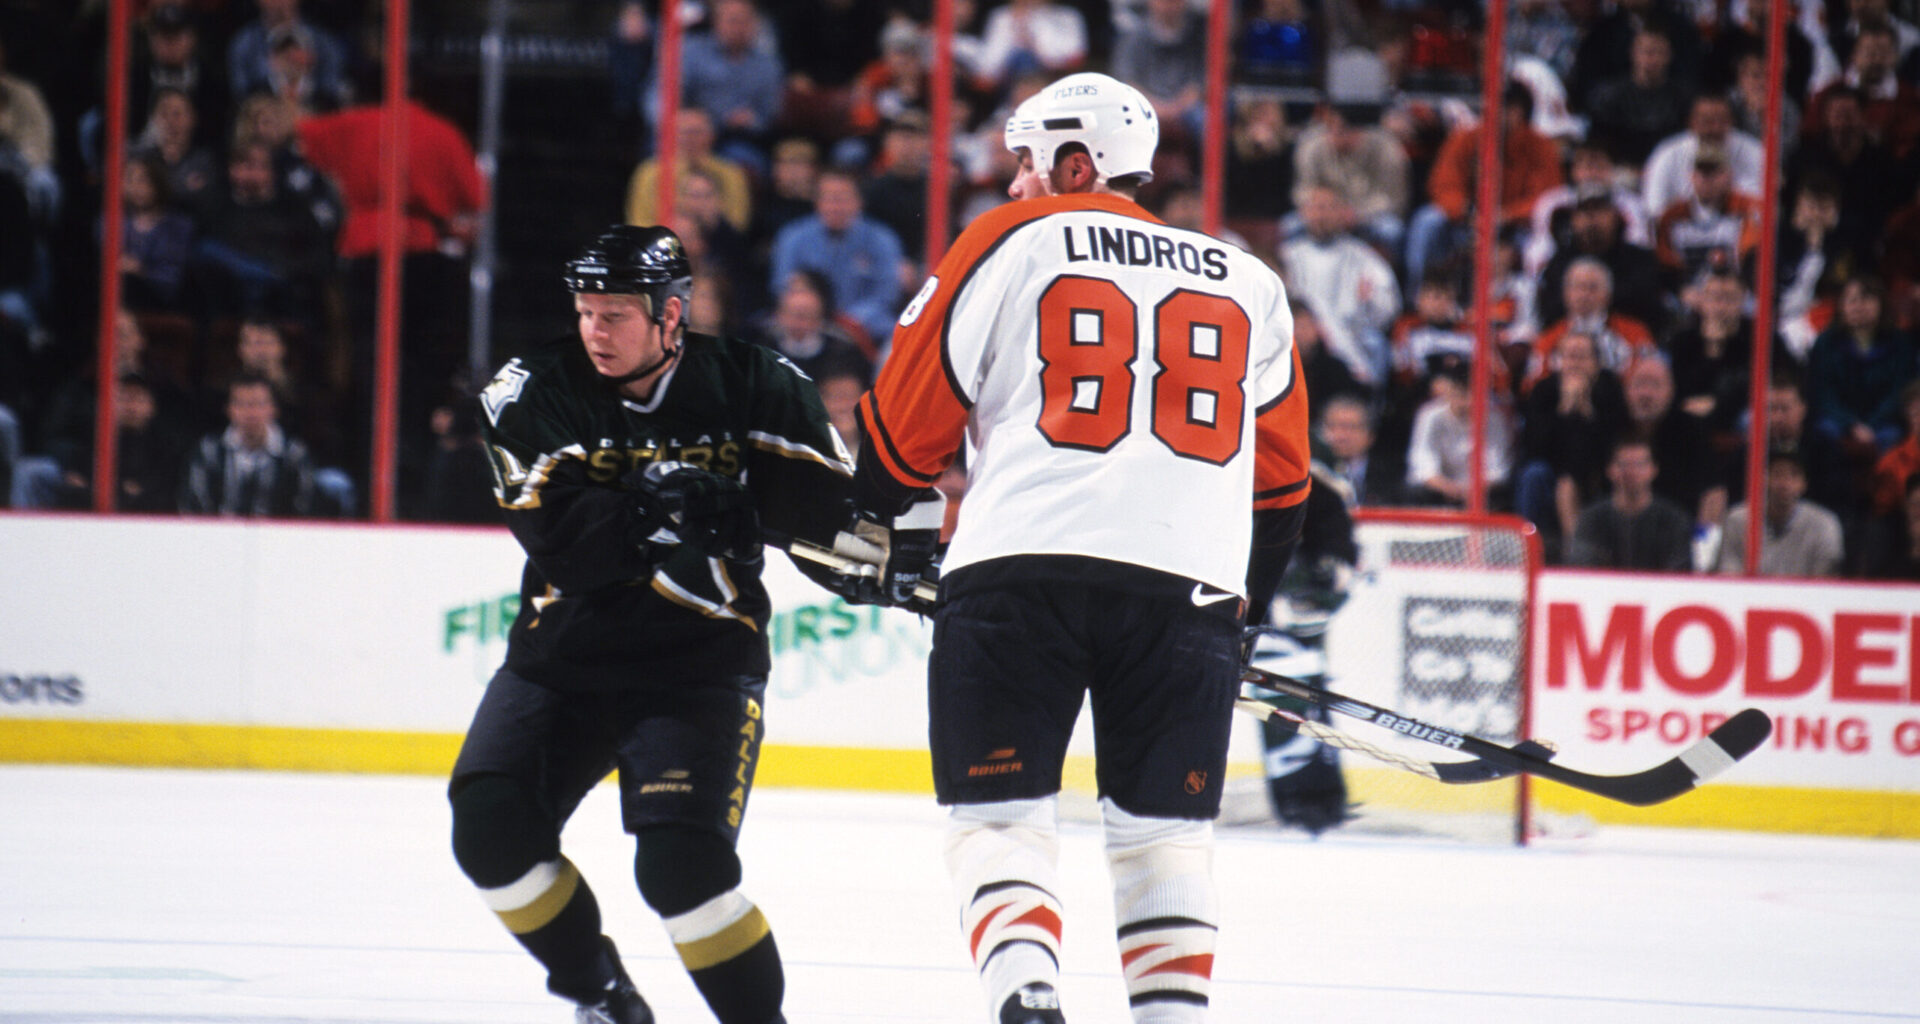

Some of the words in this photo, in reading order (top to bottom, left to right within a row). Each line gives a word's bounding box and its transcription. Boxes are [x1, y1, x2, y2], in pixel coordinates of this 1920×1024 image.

[1055, 85, 1098, 100] FLYERS
[1063, 226, 1228, 281] LINDROS
[1035, 273, 1252, 468] 88
[444, 593, 522, 653] FIR
[773, 597, 882, 656] IRST
[1546, 602, 1920, 705] MODE
[1374, 713, 1465, 750] BAUER
[1587, 707, 1869, 755] SPOING
[727, 697, 762, 828] DALLAS
